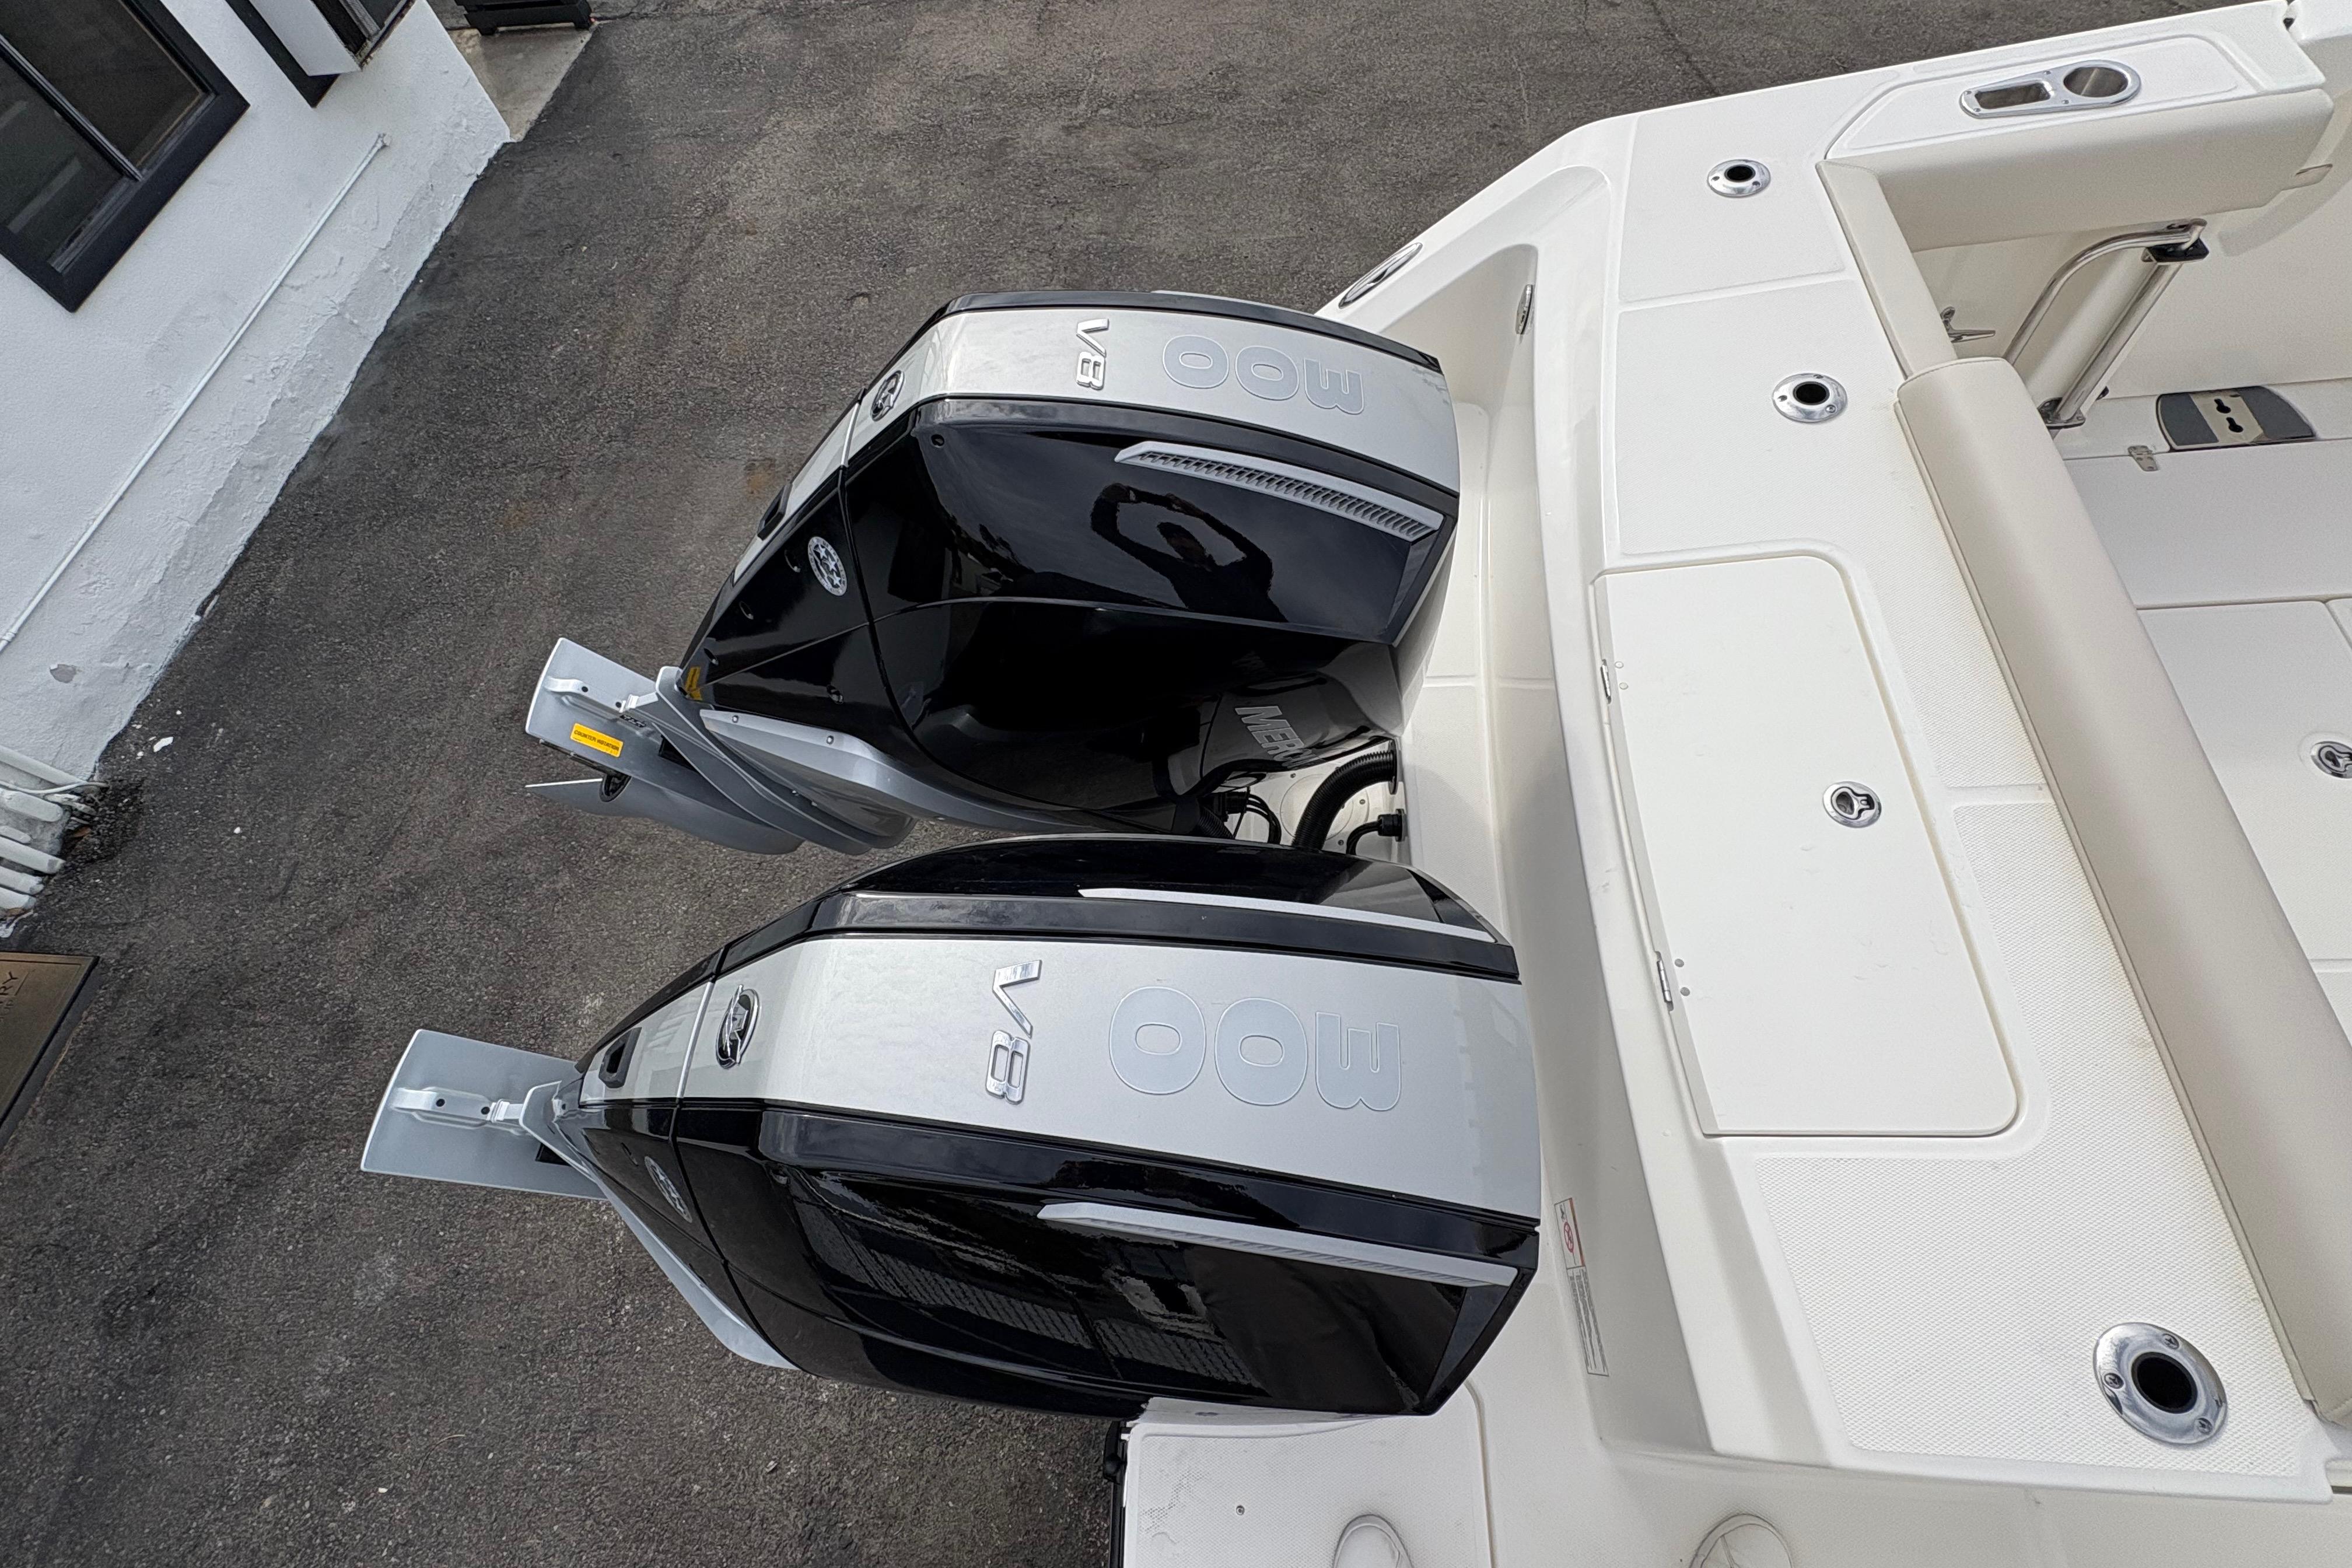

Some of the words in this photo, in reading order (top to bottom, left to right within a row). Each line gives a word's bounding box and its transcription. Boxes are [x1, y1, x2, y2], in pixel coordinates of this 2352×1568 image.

[1075, 318, 1110, 390] V8
[1163, 334, 1365, 415] 300
[985, 959, 1042, 1105] V8
[1108, 986, 1401, 1111] 300
